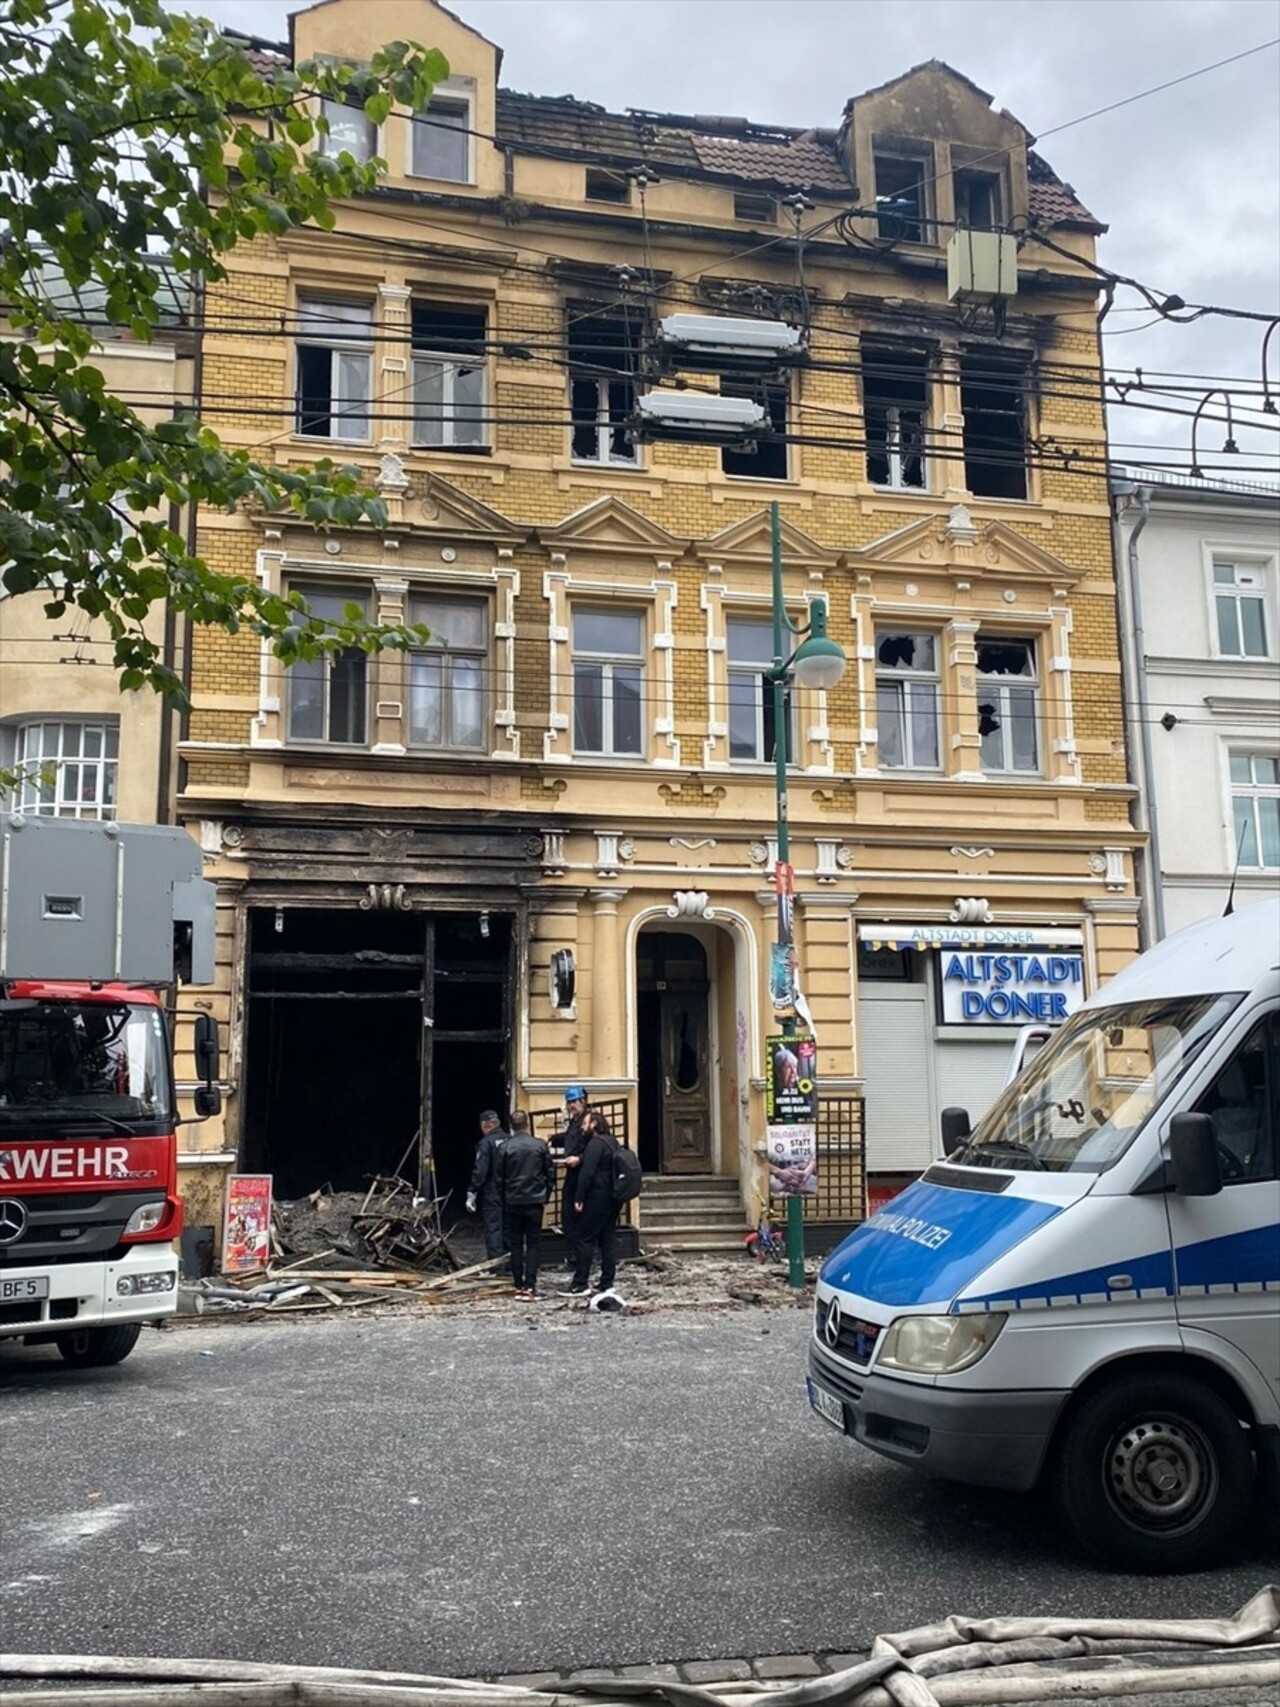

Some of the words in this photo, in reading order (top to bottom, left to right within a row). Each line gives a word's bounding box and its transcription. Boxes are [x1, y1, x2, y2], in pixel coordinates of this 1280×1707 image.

[911, 929, 979, 942] ALTSTADT
[944, 954, 1084, 985] ALTSTADT
[961, 984, 1070, 1020] DÖNER
[3, 1282, 25, 1297] BF
[26, 1281, 37, 1295] 5
